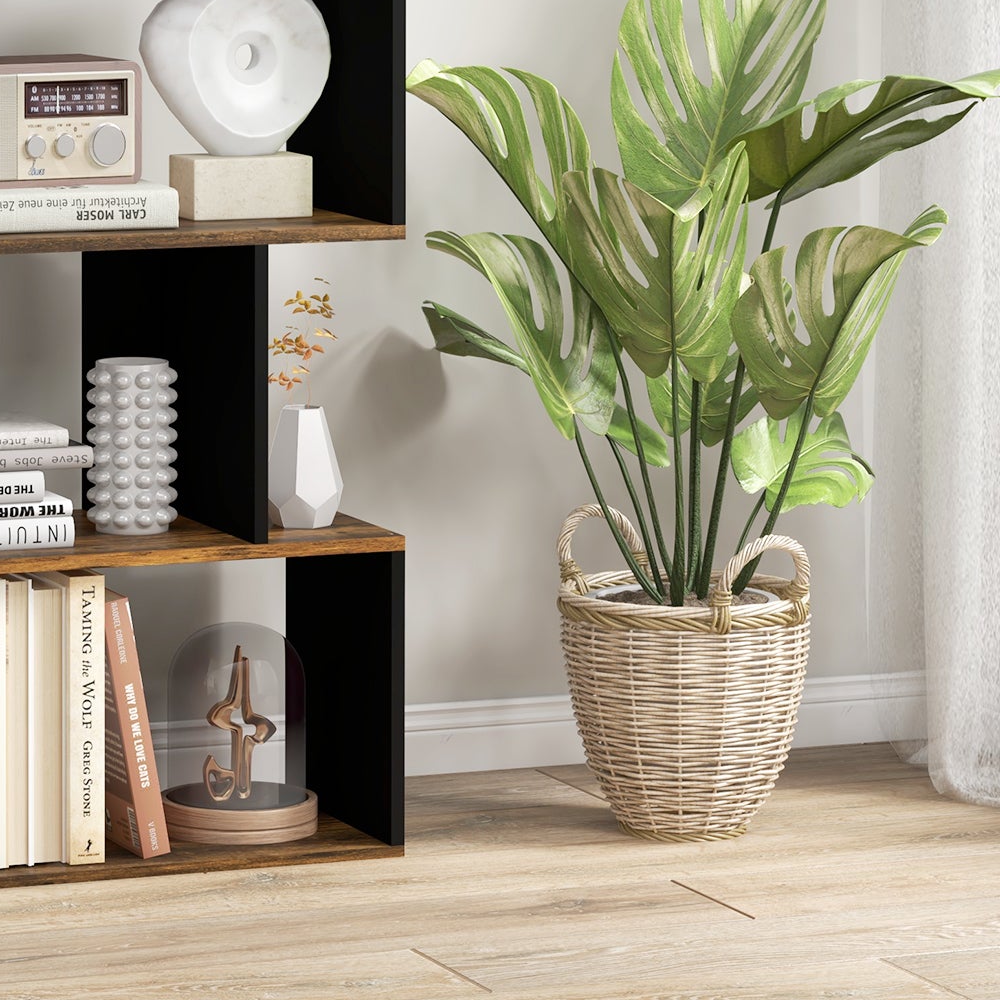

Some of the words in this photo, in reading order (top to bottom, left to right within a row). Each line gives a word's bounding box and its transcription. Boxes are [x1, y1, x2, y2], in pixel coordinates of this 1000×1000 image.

[47, 199, 68, 210] eine
[71, 198, 85, 209] für
[90, 197, 147, 208] Architektur
[76, 210, 114, 221] MOSER
[119, 209, 146, 220] CARL
[34, 437, 52, 445] The
[15, 457, 43, 466] Jobs
[52, 455, 88, 464] Steve
[14, 484, 34, 494] THE
[39, 504, 65, 515] THE
[82, 586, 95, 654] TAMING
[82, 660, 92, 677] the
[125, 683, 136, 705] WHY
[82, 680, 95, 729] WOLF
[128, 707, 139, 720] DO
[131, 722, 141, 738] WE
[134, 740, 146, 763] LOVE
[82, 741, 93, 775] GREG
[138, 764, 150, 788] CATS
[83, 778, 92, 818] STONE
